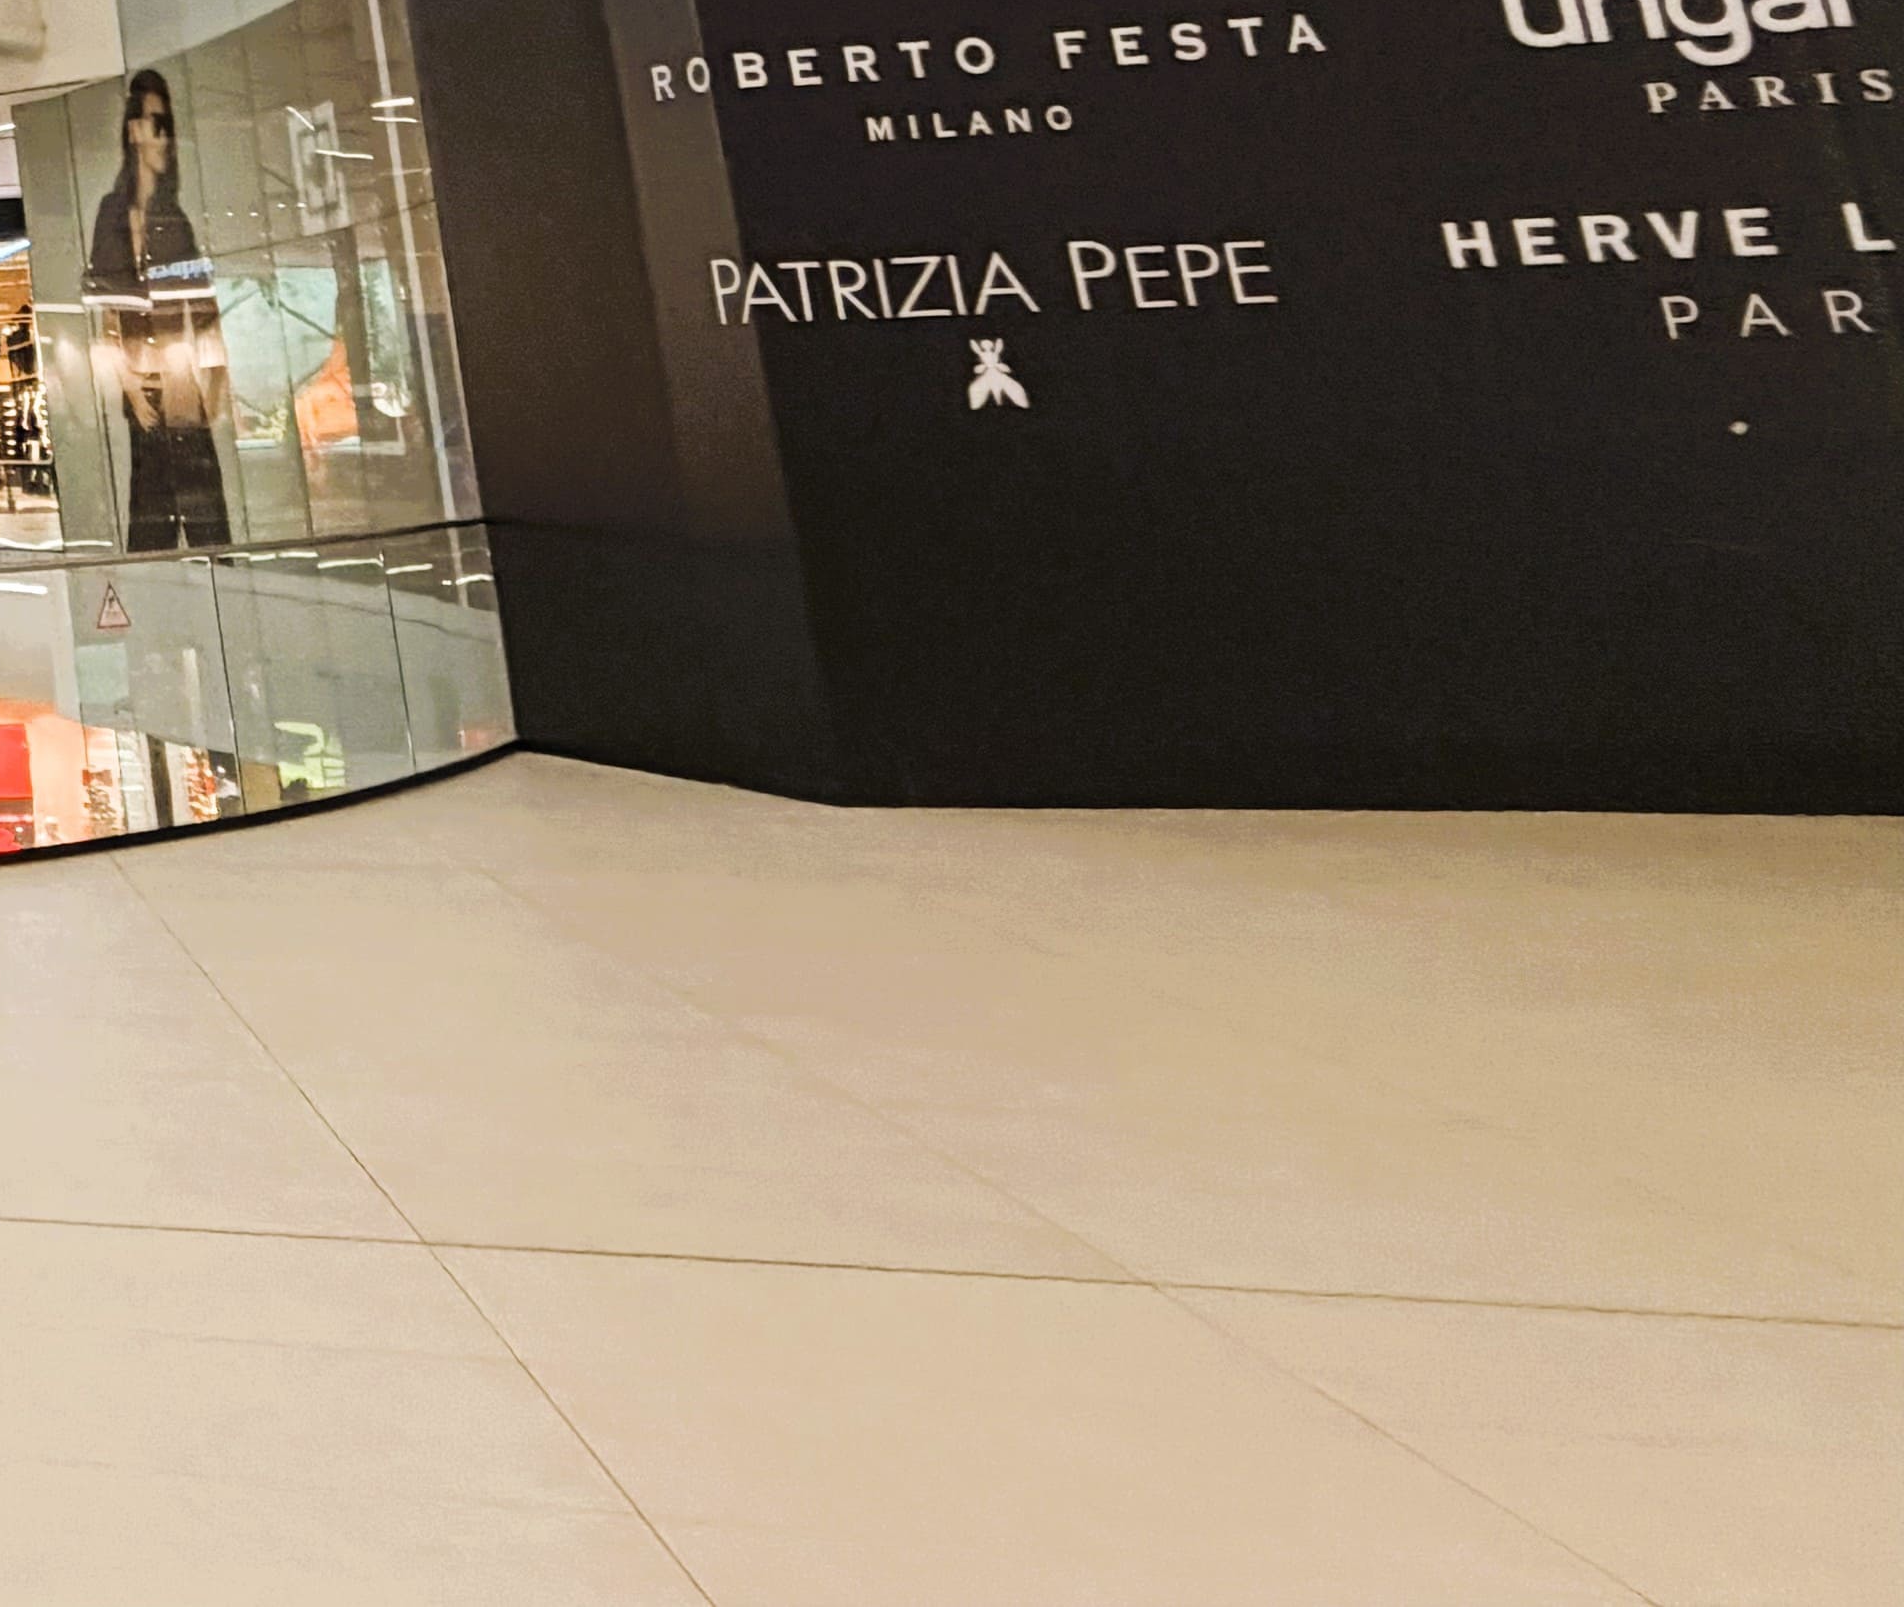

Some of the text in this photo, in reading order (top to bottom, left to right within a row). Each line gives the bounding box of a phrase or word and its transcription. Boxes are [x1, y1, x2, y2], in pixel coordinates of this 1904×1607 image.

[652, 14, 1327, 102] ROBERTO FESTA
[1643, 69, 1894, 113] PARIS
[867, 105, 1074, 142] MILANO
[1441, 207, 1780, 269] HERVE
[711, 241, 1279, 325] PATRIZIA PEPE
[1660, 290, 1876, 340] PAR
